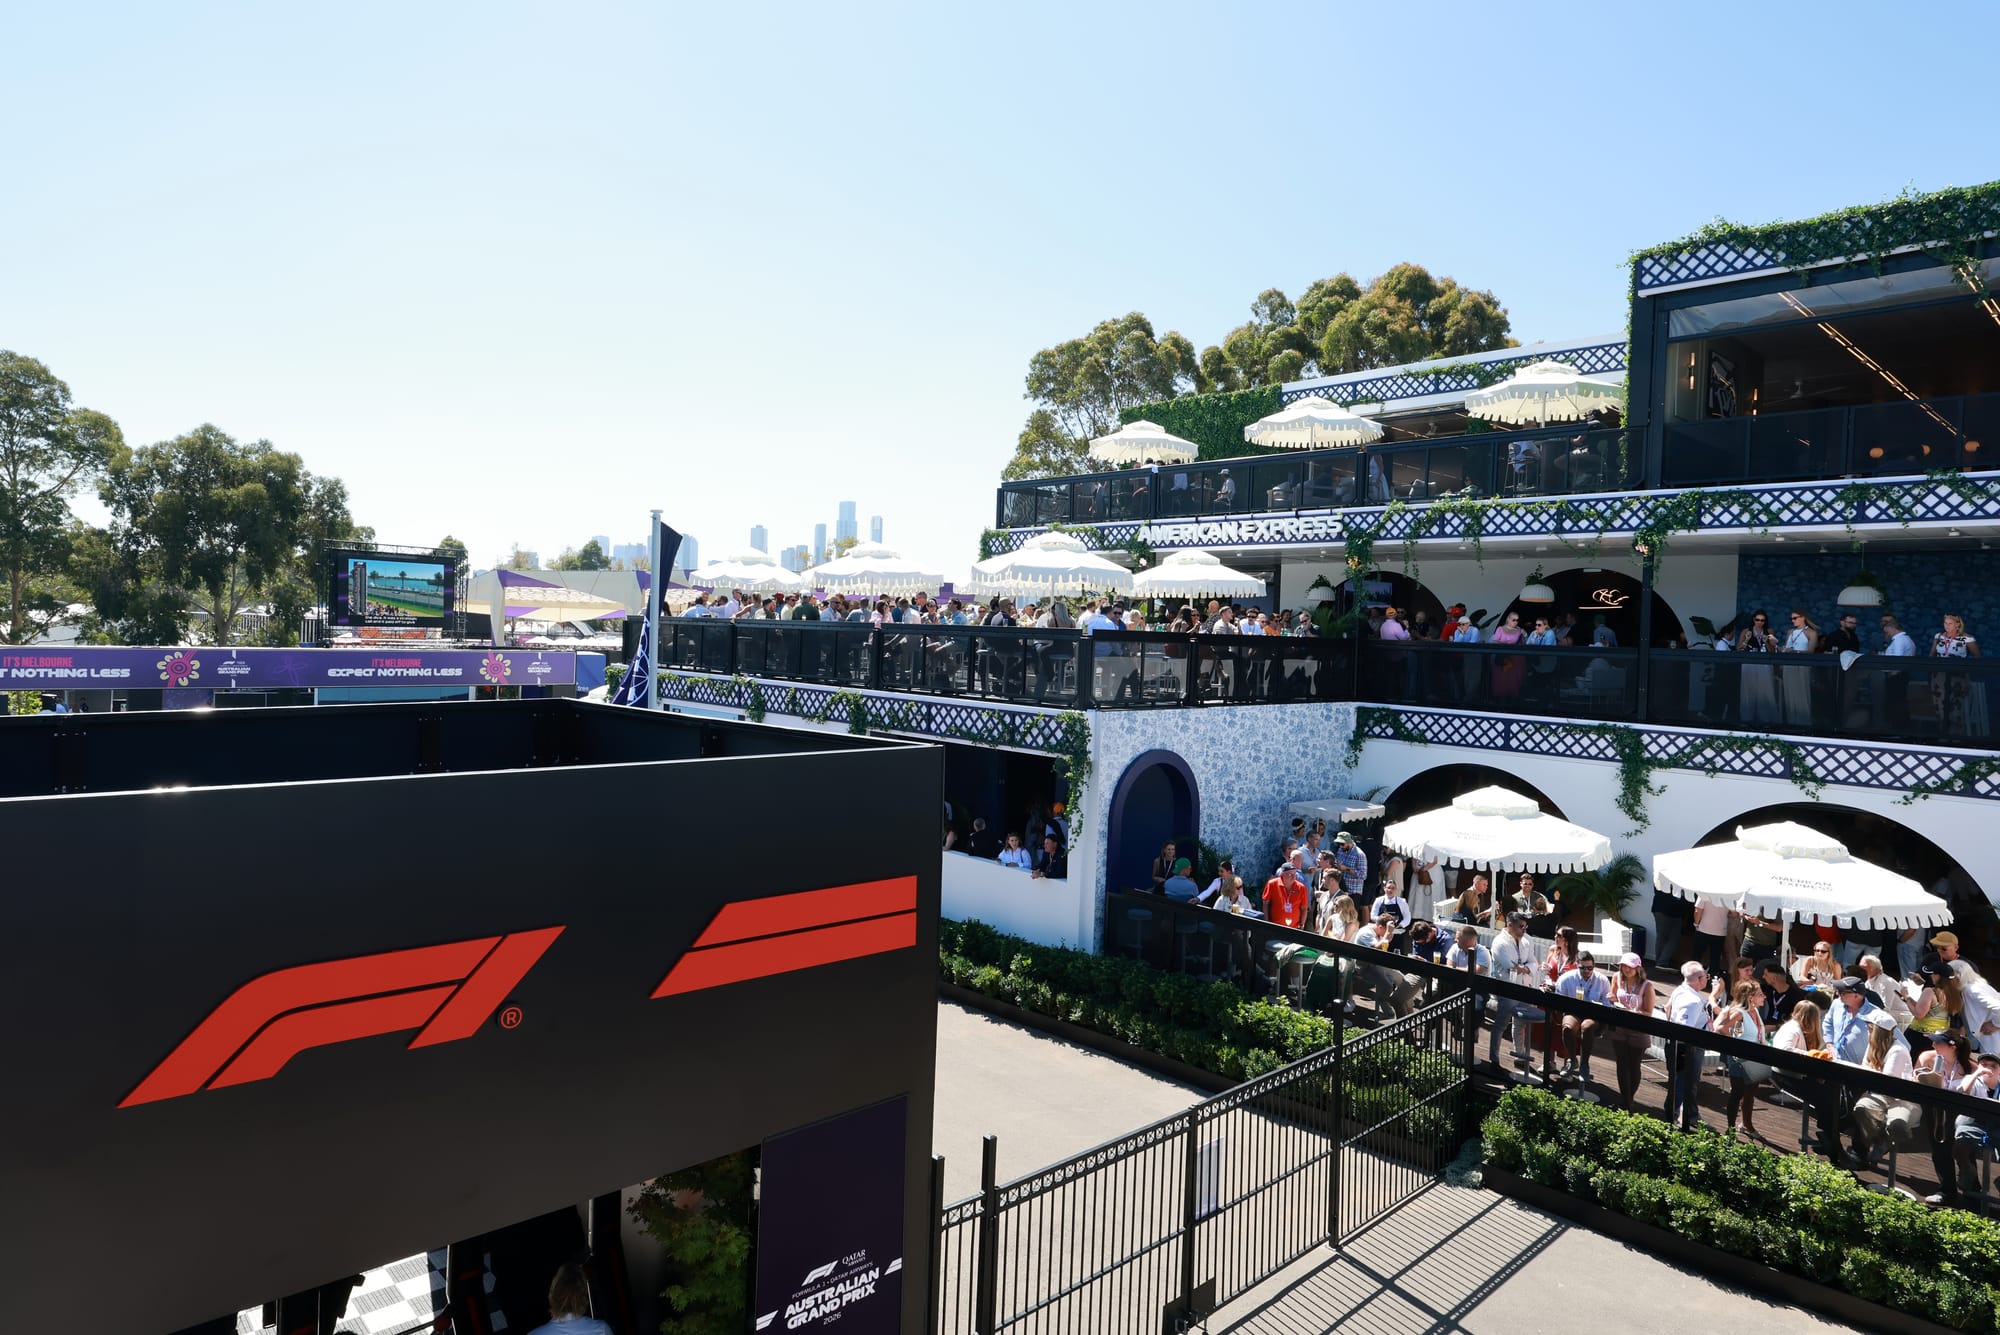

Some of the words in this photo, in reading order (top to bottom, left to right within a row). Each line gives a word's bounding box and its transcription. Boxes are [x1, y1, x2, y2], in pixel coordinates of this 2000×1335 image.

[1137, 521, 1239, 543] AMERICAN
[1242, 515, 1343, 540] EXPRESS
[3, 656, 20, 668] IT'S
[21, 656, 73, 668] MELBOURNE
[385, 658, 421, 668] MELBOURNE
[11, 668, 88, 678] NOTHING
[90, 668, 131, 678] LESS
[327, 668, 376, 677] EXPECT
[377, 668, 432, 677] NOTHING
[433, 668, 463, 676] LESS
[1770, 875, 1832, 887] AMERICAN
[1778, 880, 1833, 892] EXPRESS
[842, 1249, 866, 1265] QATAR
[791, 1283, 821, 1299] FORMULA
[830, 1271, 849, 1284] QATAR
[849, 1261, 874, 1275] AIRWAYS
[784, 1266, 880, 1319] AUSTRALIAN
[786, 1297, 841, 1330] GRAND
[841, 1281, 876, 1307] PRIX
[823, 1311, 842, 1326] 2026
